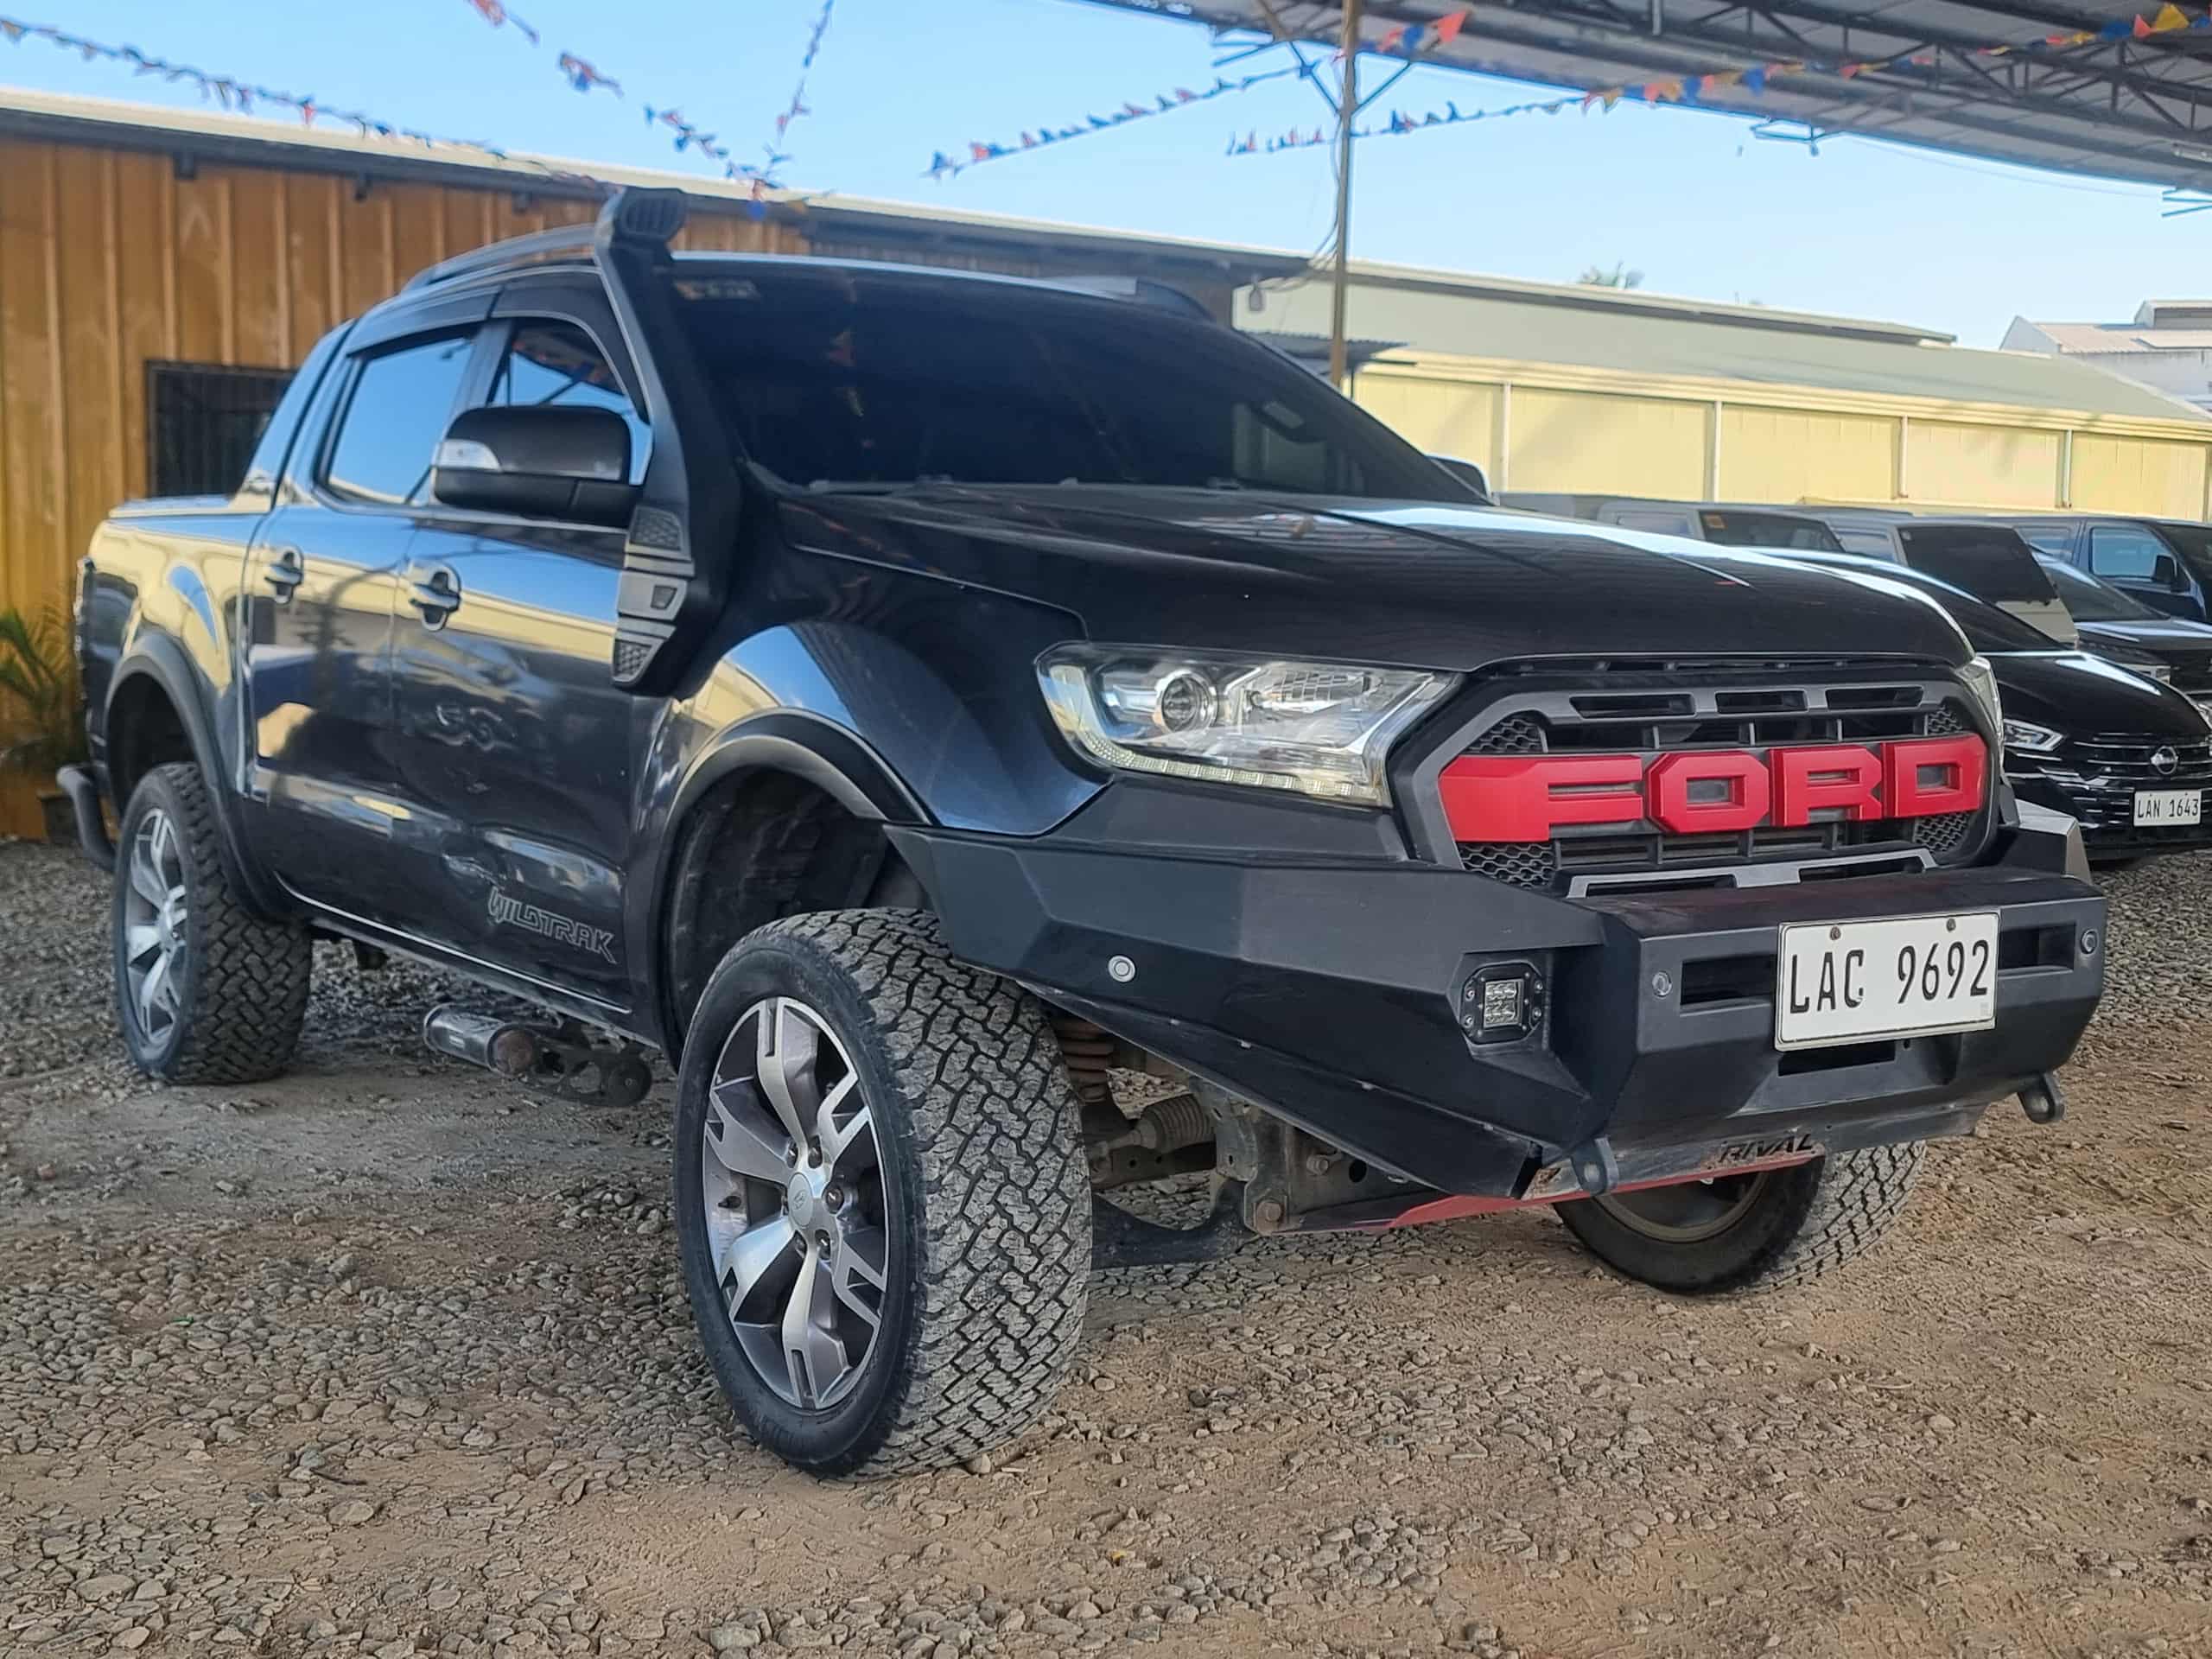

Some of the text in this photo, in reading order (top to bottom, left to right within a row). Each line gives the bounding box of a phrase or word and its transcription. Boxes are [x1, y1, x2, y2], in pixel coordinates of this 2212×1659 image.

[1439, 732, 1986, 842] FORD
[2137, 798, 2199, 818] LAN 1643
[488, 886, 618, 965] WILDTRAK
[1789, 939, 1989, 1014] LAC 9692
[1719, 1133, 1813, 1163] RIVAL
